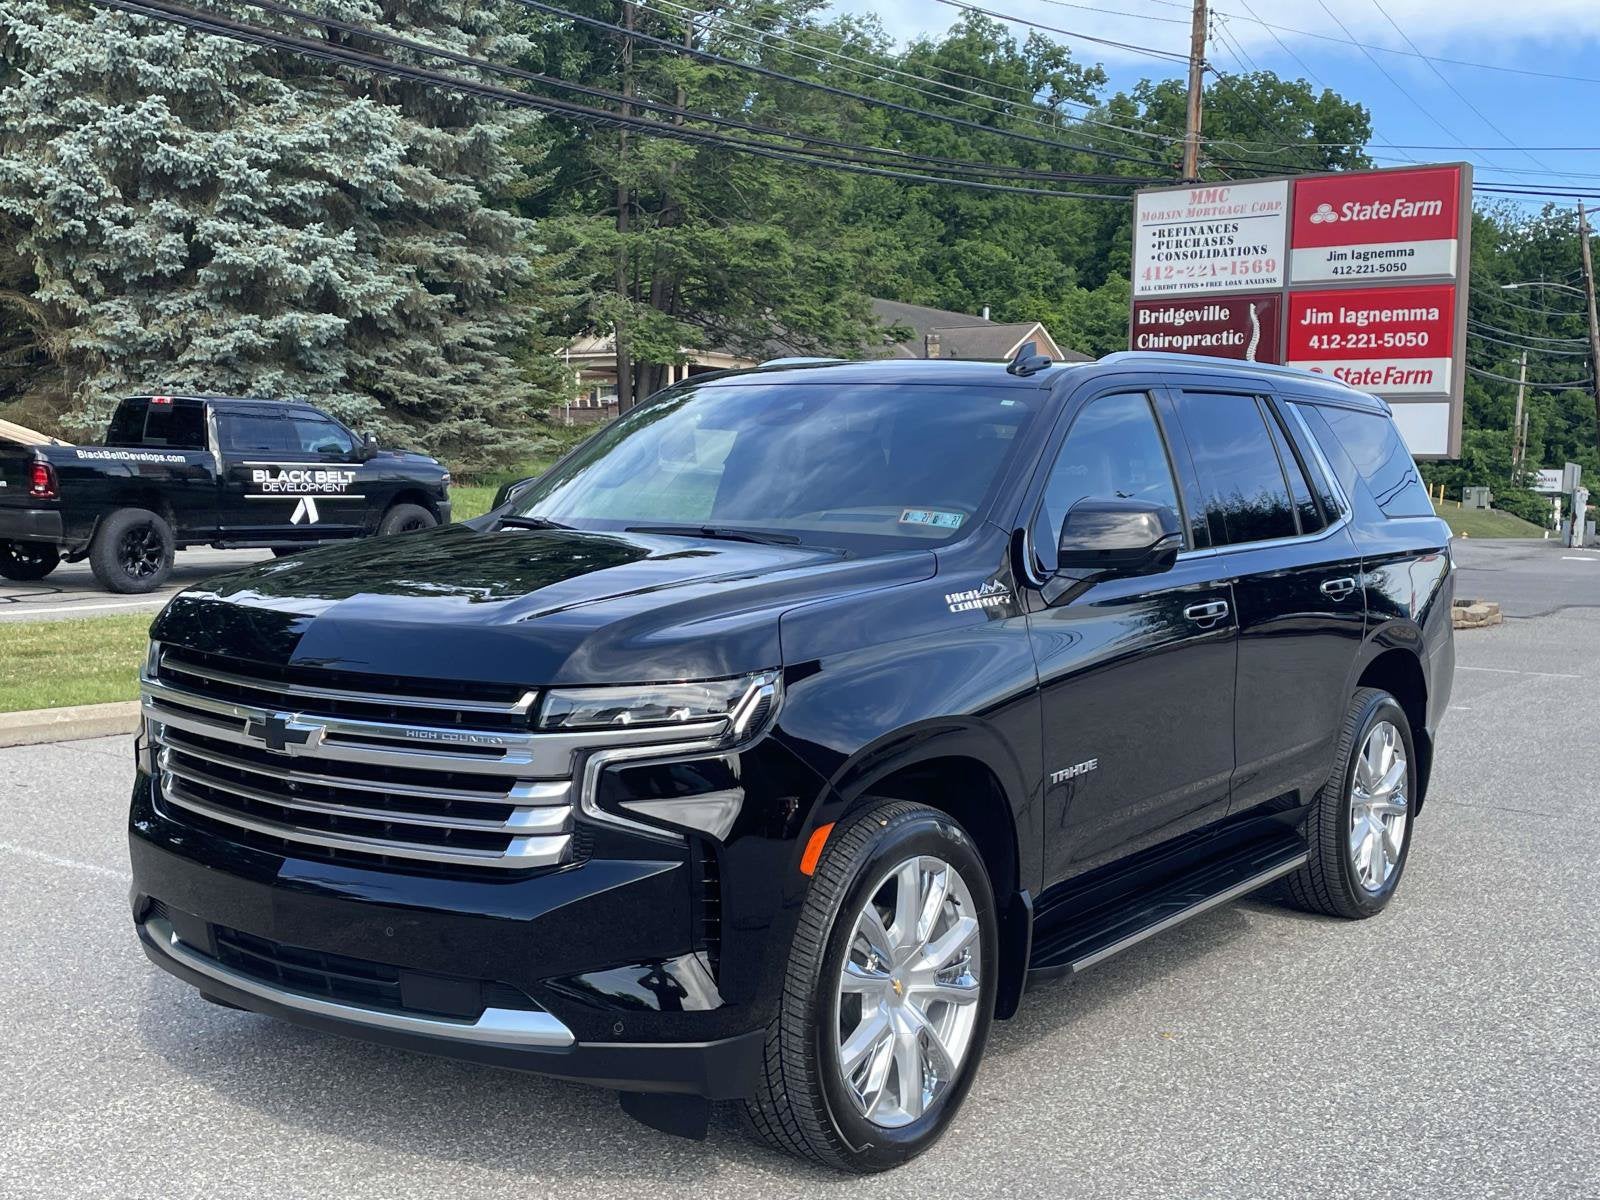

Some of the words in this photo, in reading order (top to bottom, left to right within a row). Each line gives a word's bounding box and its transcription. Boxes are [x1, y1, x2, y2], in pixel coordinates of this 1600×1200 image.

[1189, 188, 1231, 205] MMC
[1185, 204, 1248, 218] MORTGAGE
[1158, 222, 1239, 238] REFINANCES
[1157, 235, 1234, 250] PURCHASES
[1156, 244, 1268, 262] CONSOLIDATIONS
[1327, 250, 1348, 262] Jim
[1351, 248, 1415, 263] Iagnemma
[1332, 262, 1407, 275] 412-221-5050
[1140, 284, 1151, 292] ALL
[1154, 283, 1177, 291] CREDIT
[1178, 282, 1199, 290] TYPES
[1225, 279, 1243, 287] LOAN
[1245, 277, 1277, 286] ANALYSIS
[1138, 305, 1230, 326] Bridgeville
[1301, 308, 1333, 325] Jim
[1340, 306, 1439, 326] Iagnemma
[1137, 329, 1244, 350] Chiropractic
[1308, 331, 1429, 350] 412-221-5050
[76, 449, 186, 463] BlackBeltDevelops.com
[252, 469, 312, 483] BLACK
[315, 470, 356, 484] BELT
[262, 482, 348, 492] DEVELOPMENT
[945, 589, 981, 604] HIGH
[406, 730, 437, 739] HIGH
[1050, 758, 1098, 784] TAHOE
